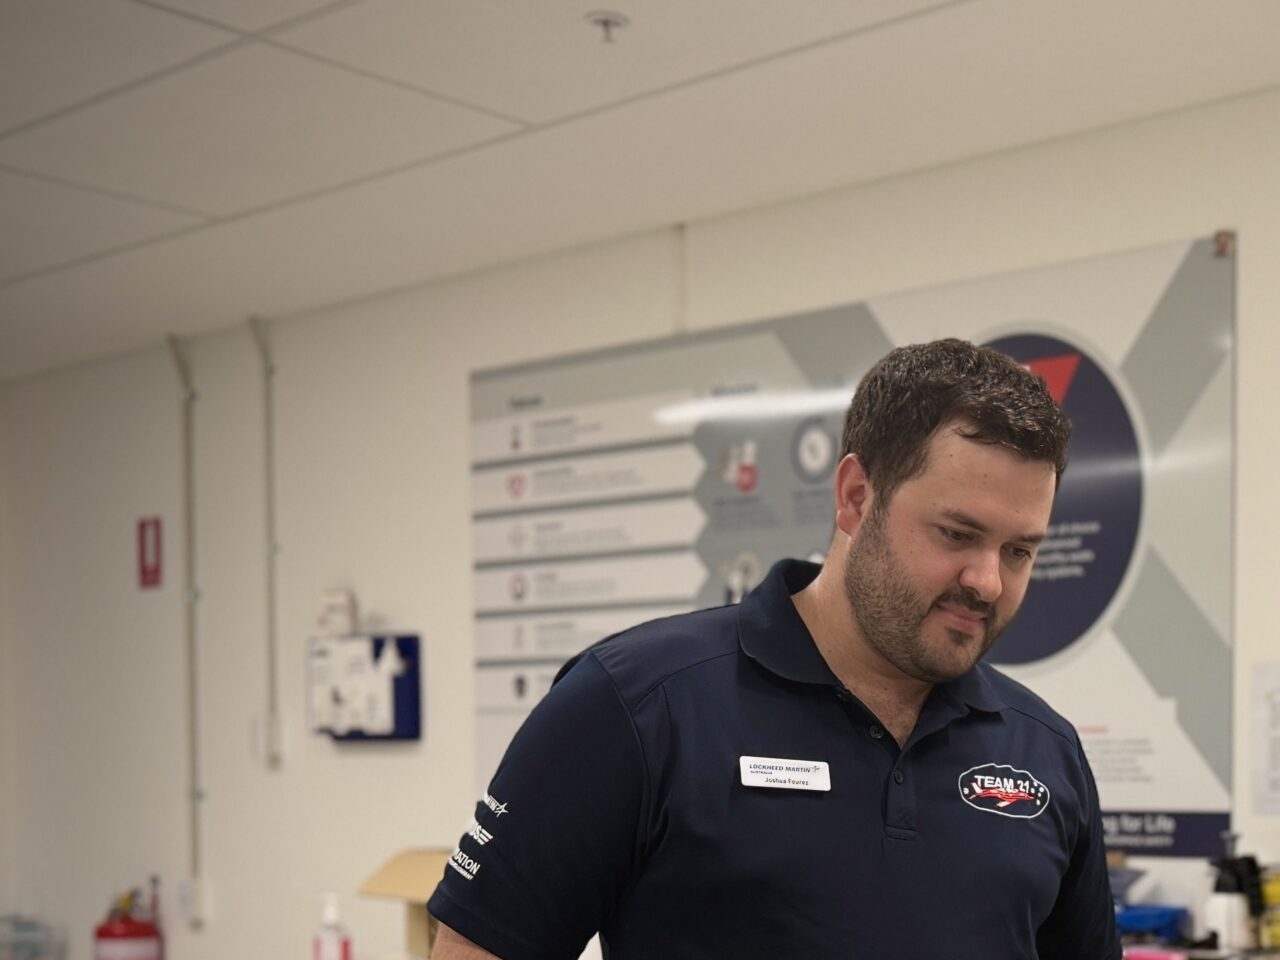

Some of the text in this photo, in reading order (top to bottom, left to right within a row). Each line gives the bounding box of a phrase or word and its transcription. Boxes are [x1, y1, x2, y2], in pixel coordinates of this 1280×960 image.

[749, 764, 811, 774] LOCKHEED MARTIN
[765, 777, 787, 785] Joshua
[974, 775, 1030, 794] TEAM 21
